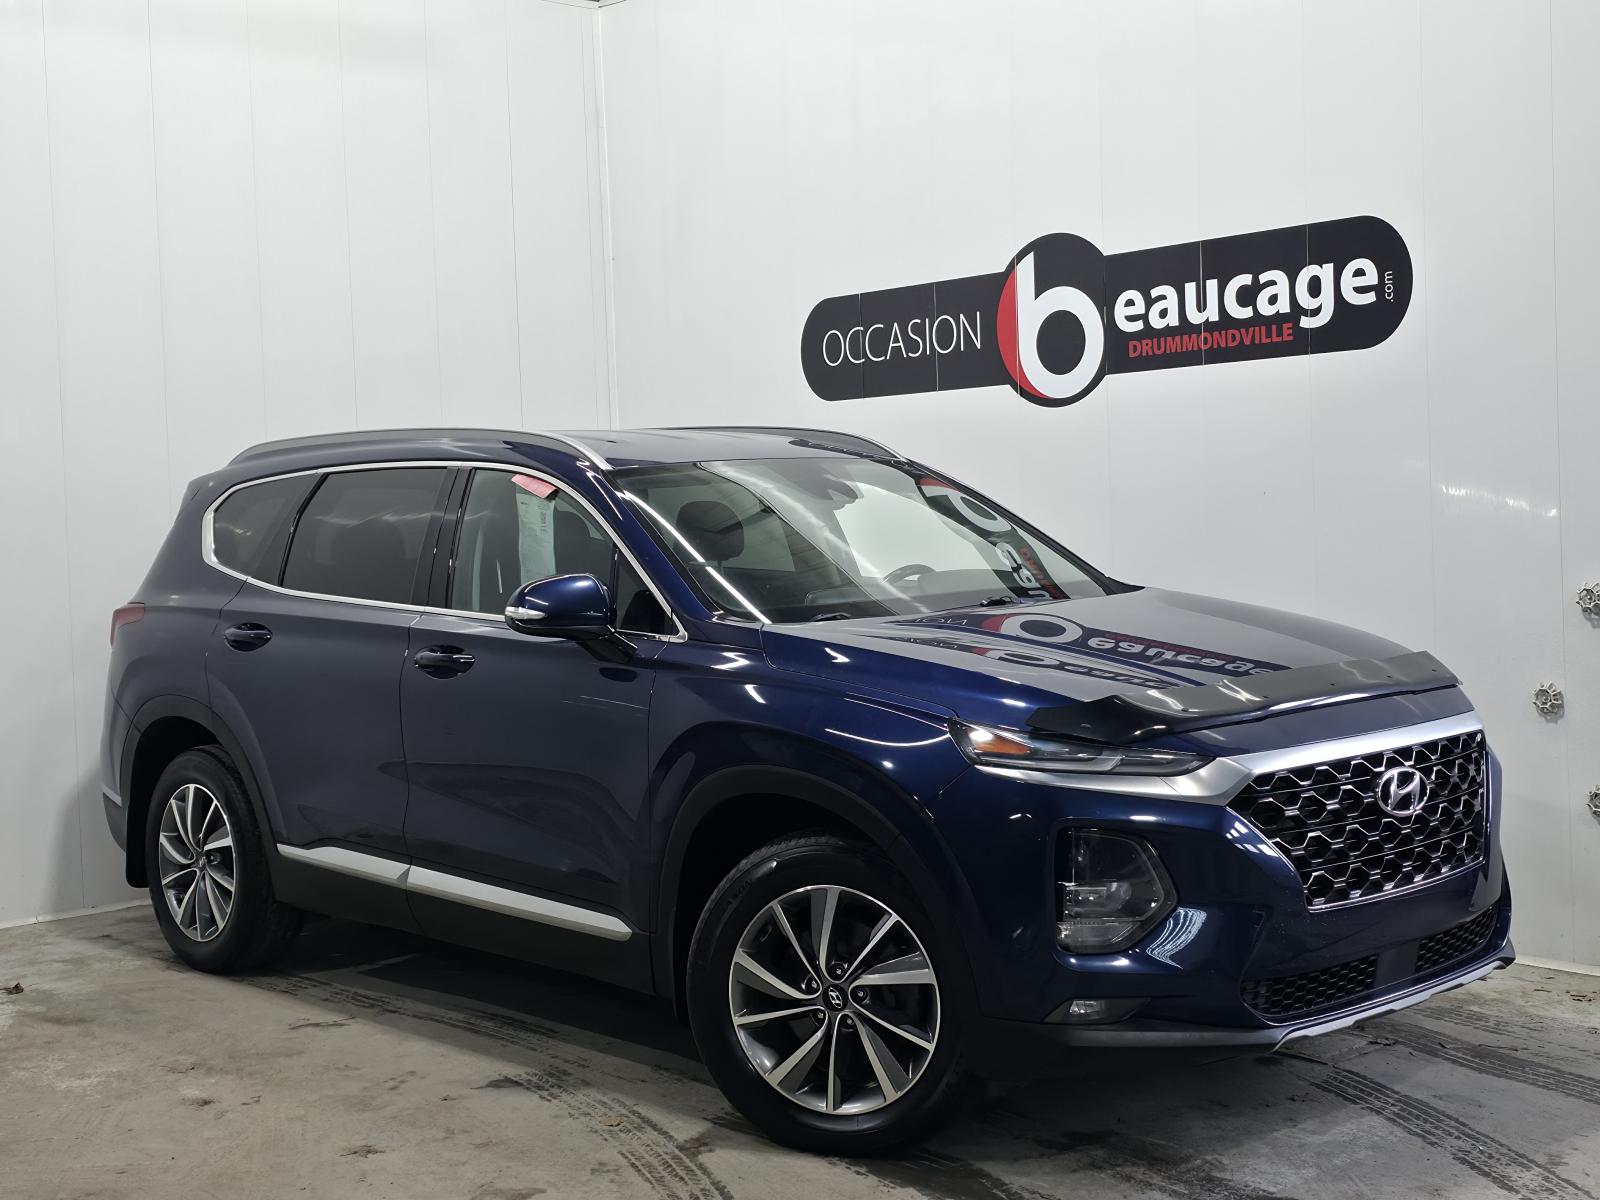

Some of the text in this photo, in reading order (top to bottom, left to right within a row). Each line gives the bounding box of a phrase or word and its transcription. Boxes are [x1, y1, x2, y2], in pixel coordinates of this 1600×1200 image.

[823, 311, 981, 366] OCCASION
[1384, 270, 1394, 302] .com
[1128, 323, 1294, 358] DRUMMONDVILLE
